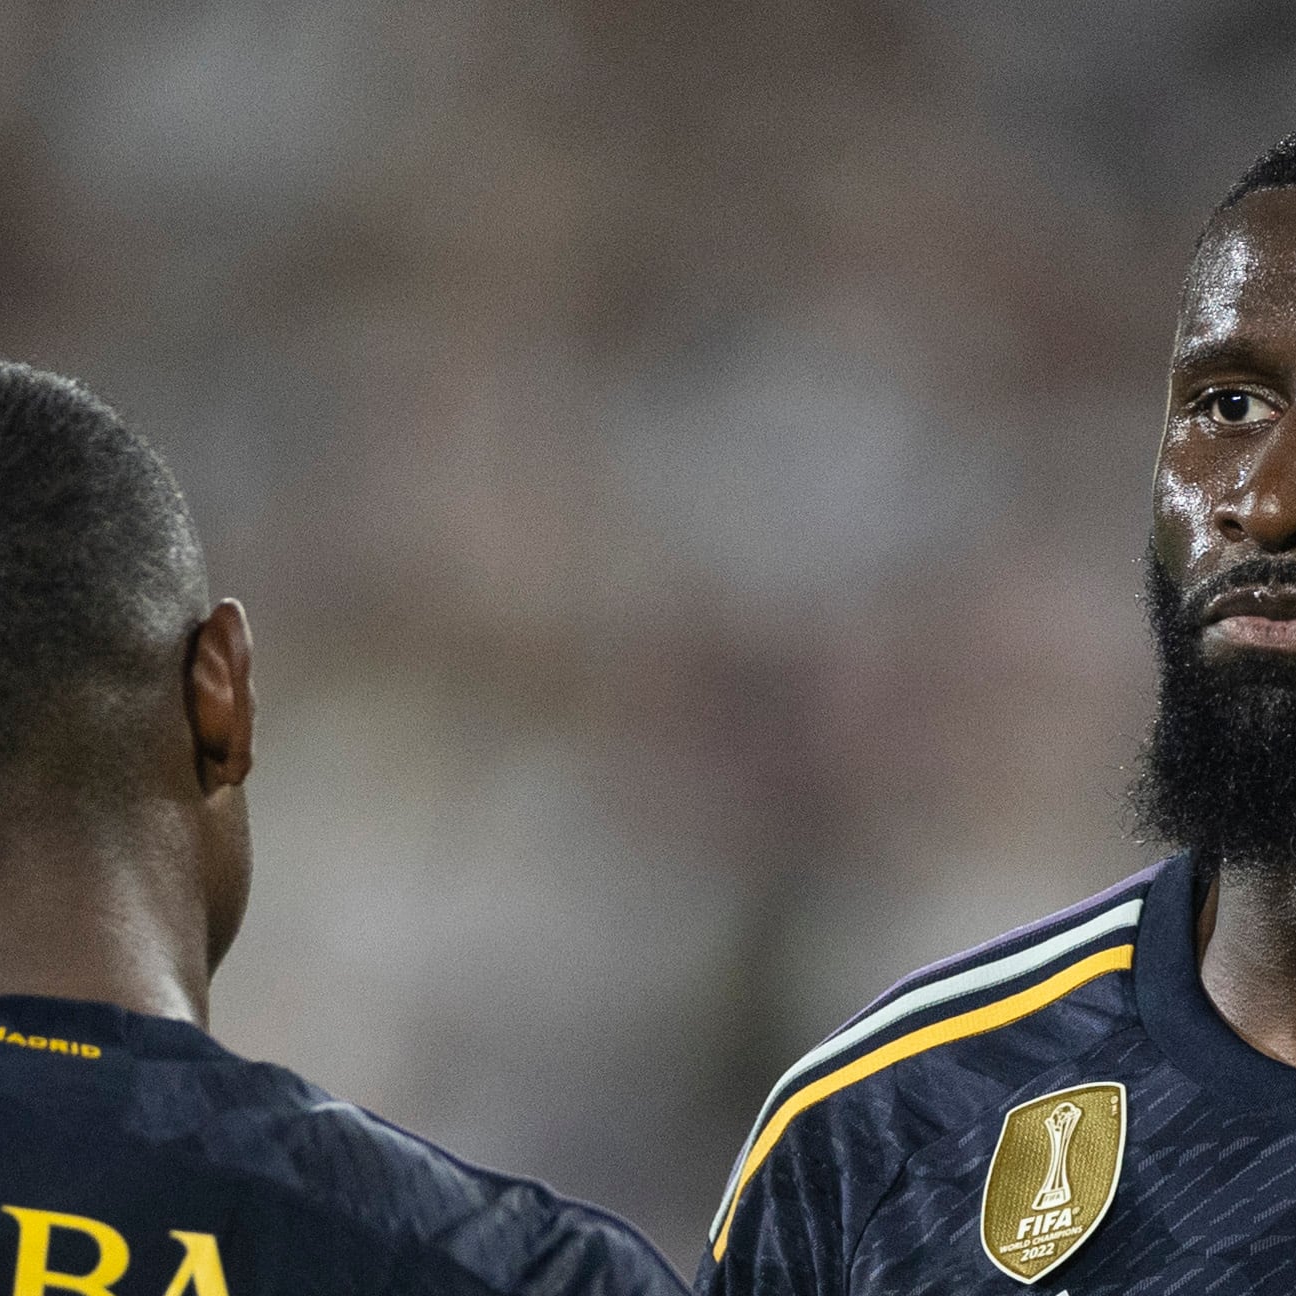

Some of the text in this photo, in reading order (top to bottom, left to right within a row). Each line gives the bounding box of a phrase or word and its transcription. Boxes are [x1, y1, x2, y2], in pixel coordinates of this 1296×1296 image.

[1016, 1208, 1073, 1240] FIFA
[999, 1225, 1083, 1254] WORLD CHAMPIONS
[1020, 1242, 1055, 1262] 2022
